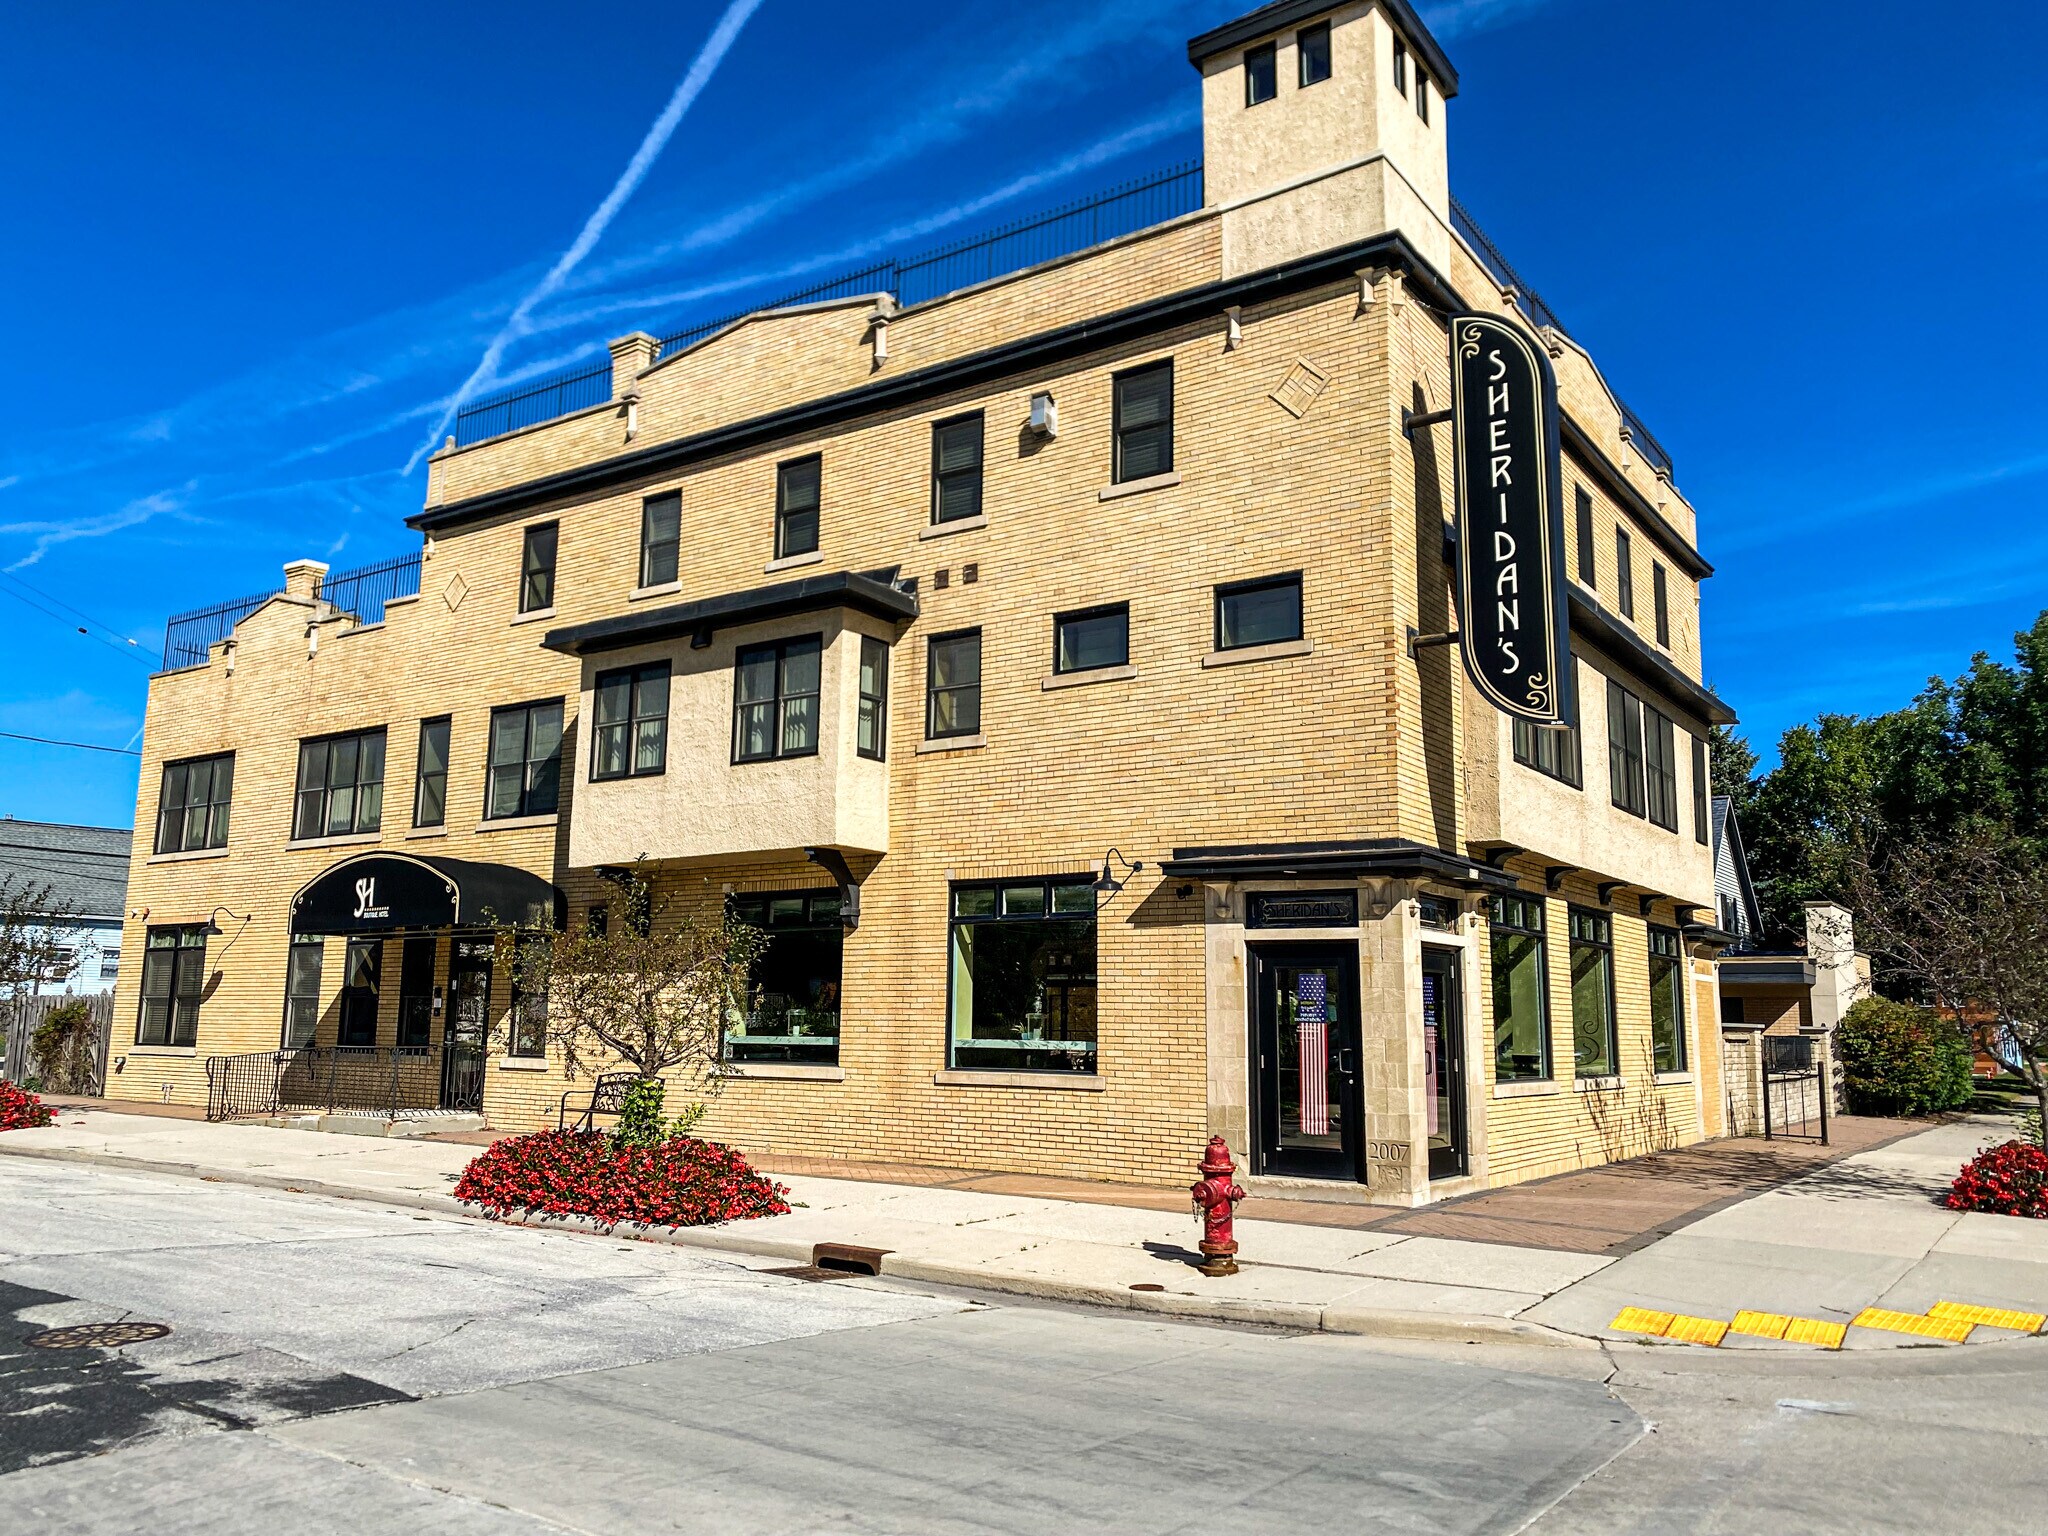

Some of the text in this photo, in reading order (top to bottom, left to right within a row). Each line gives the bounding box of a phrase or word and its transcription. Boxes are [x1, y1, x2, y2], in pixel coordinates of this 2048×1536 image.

[1488, 349, 1520, 674] SHERIDAN'S
[1265, 902, 1341, 918] SHERIDAN'S
[1369, 1142, 1410, 1162] 2007
